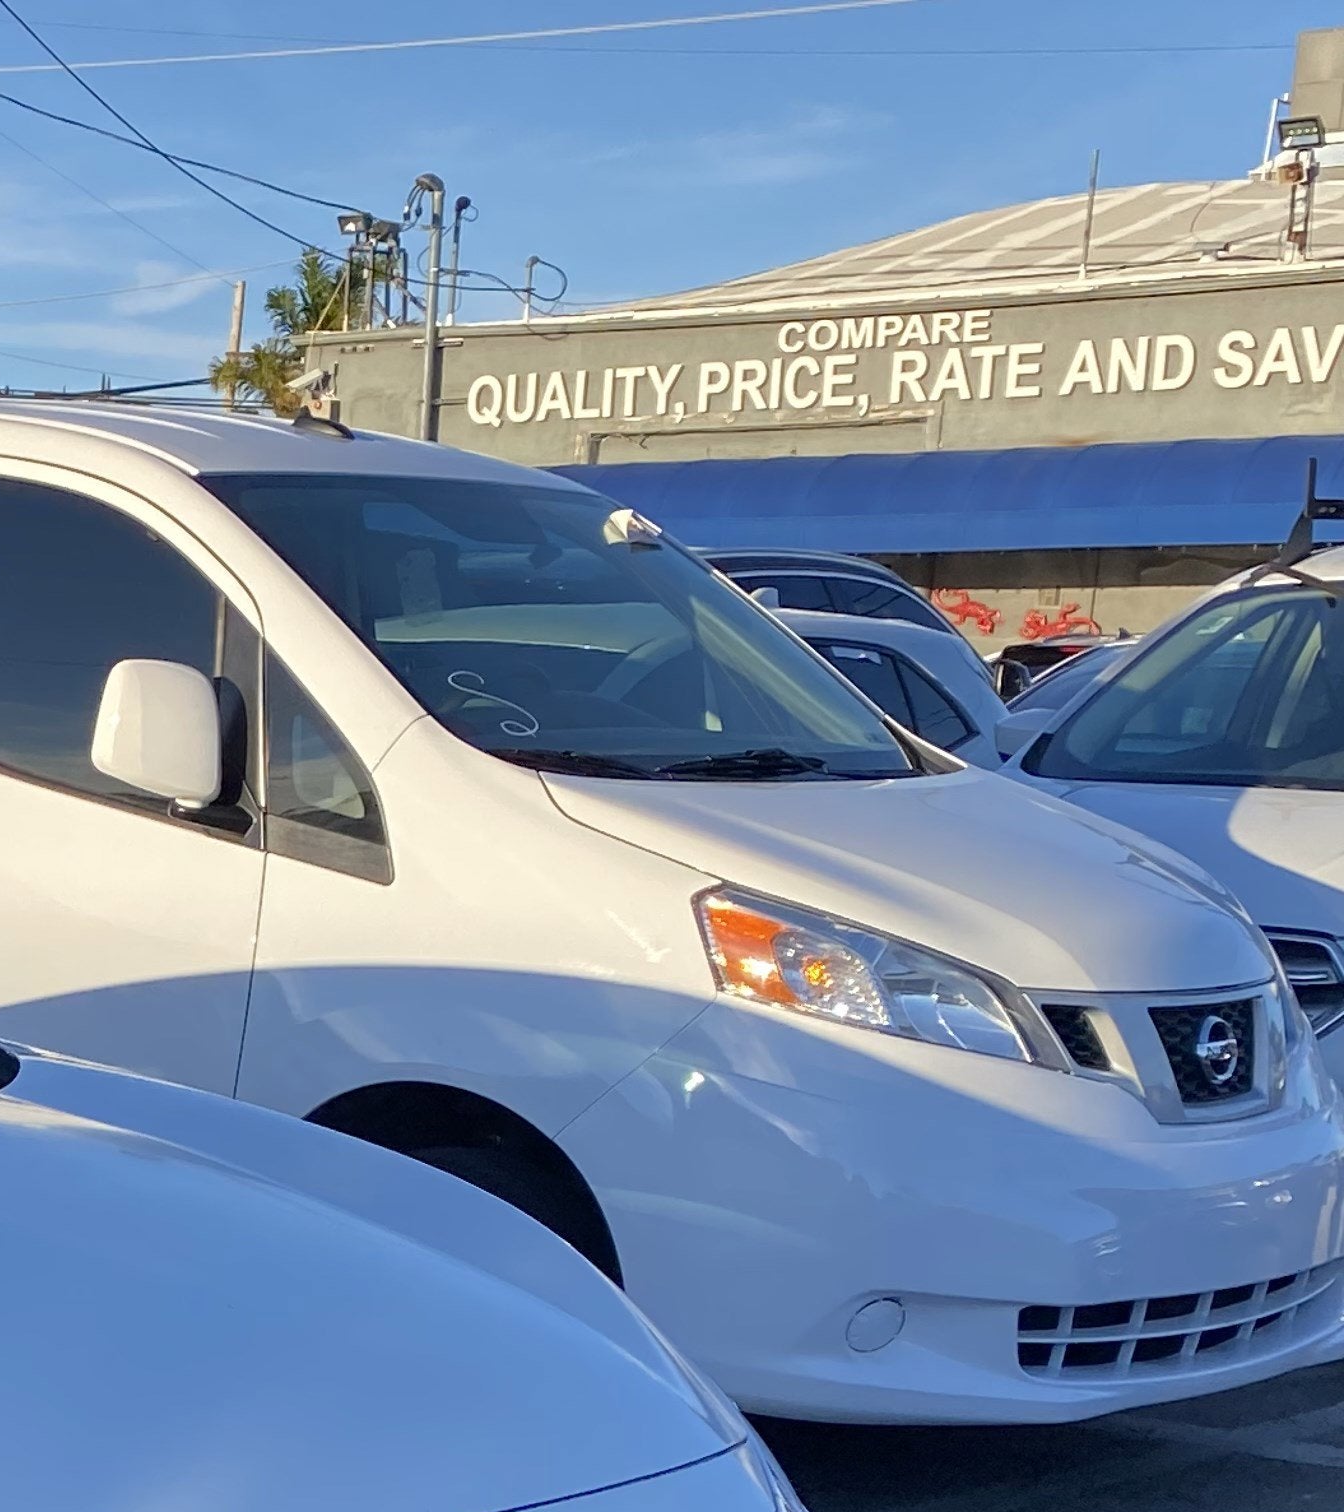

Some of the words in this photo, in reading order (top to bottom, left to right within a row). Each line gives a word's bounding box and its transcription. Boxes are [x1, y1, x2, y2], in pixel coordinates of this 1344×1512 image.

[778, 309, 992, 354] COMPARE
[467, 363, 686, 428] QUALITY,
[697, 353, 870, 417] PRICE,
[889, 341, 1046, 404] RATE
[1058, 333, 1197, 397] AND
